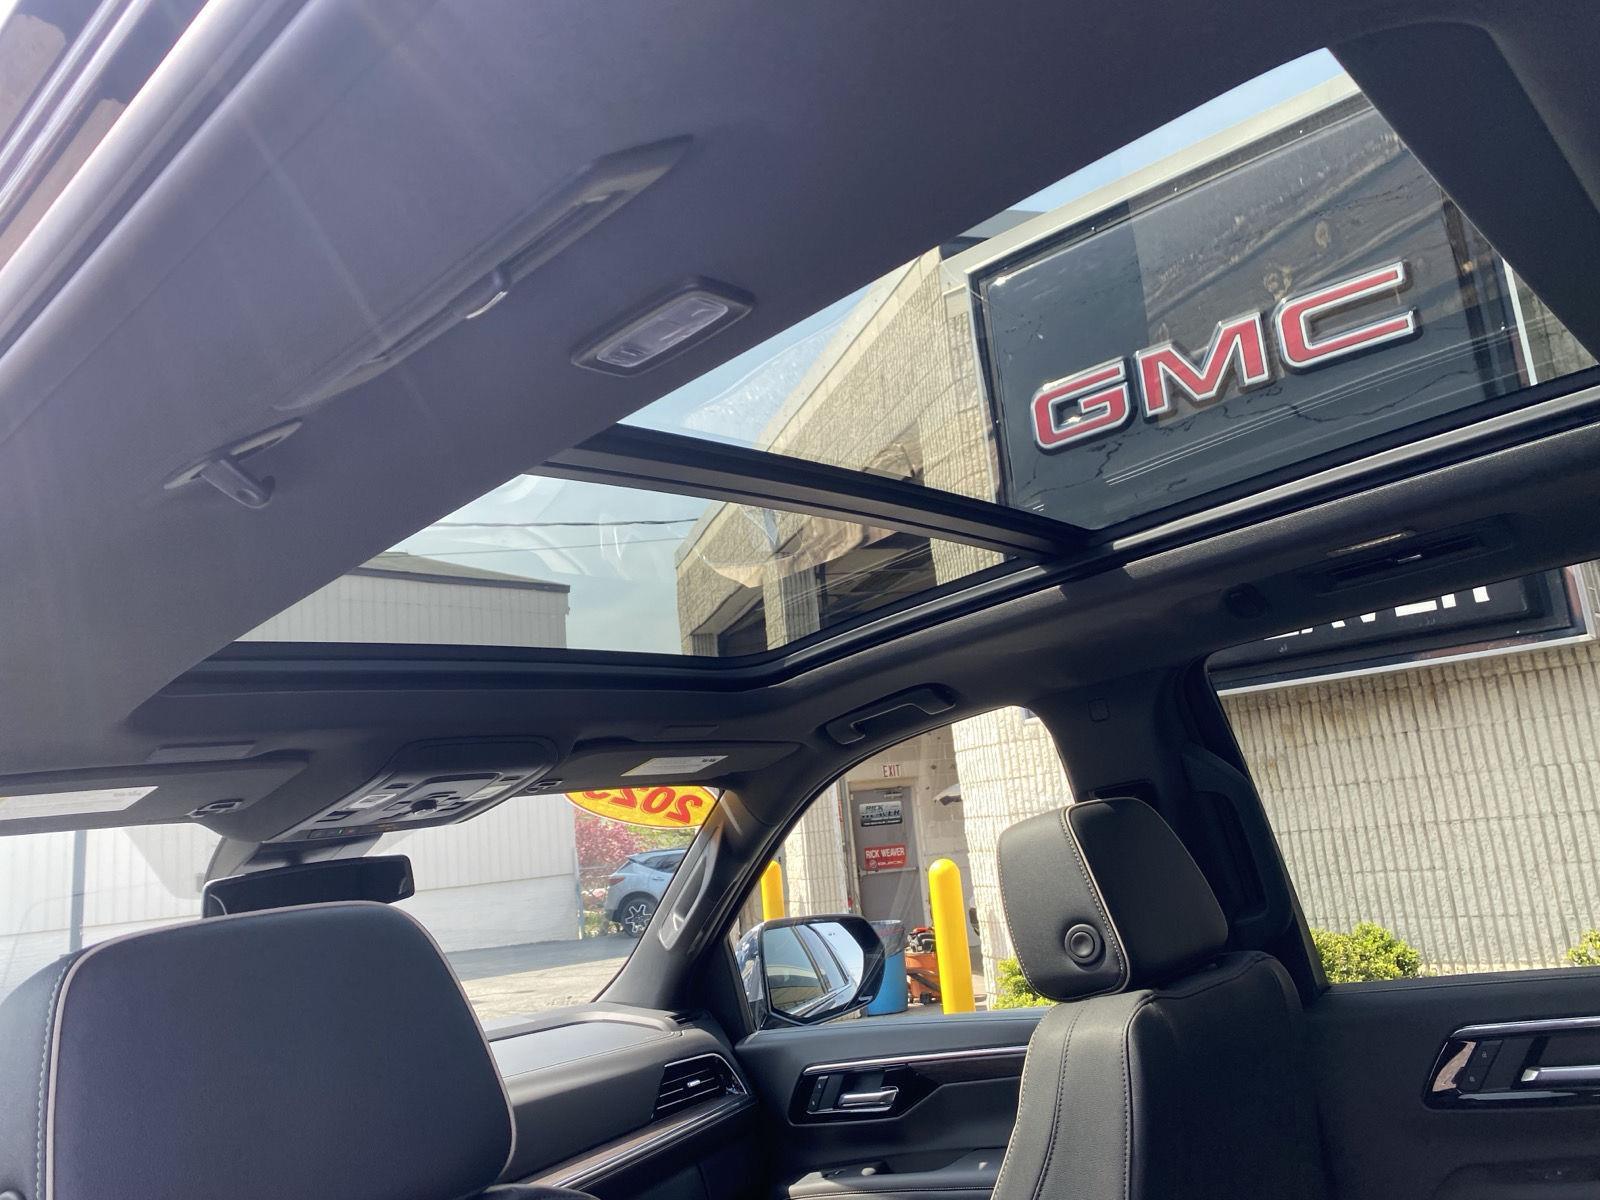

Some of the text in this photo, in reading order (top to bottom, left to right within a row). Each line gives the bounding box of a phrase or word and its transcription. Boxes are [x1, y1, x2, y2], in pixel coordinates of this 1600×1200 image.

[1031, 261, 1416, 450] GMC
[882, 764, 901, 778] EXIT
[865, 847, 905, 860] RICK WEAVER
